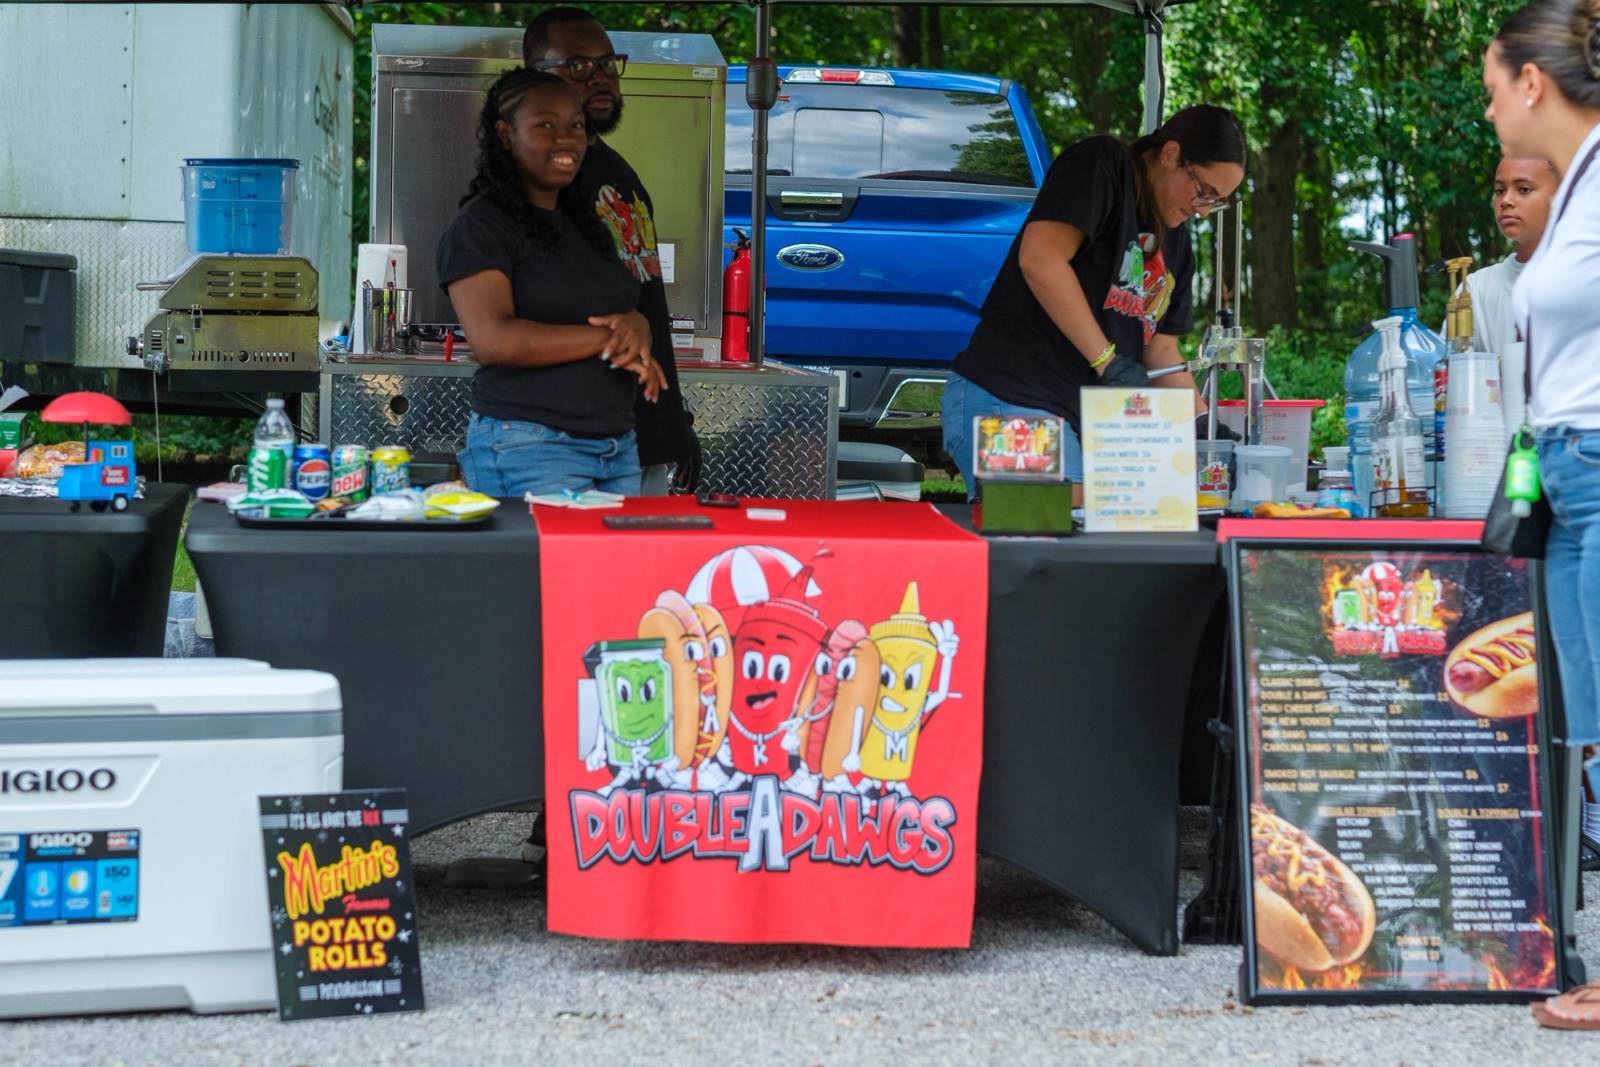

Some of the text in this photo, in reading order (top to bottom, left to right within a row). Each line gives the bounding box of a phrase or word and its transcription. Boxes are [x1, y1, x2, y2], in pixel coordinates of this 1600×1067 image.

[791, 249, 828, 265] Ford
[332, 469, 366, 495] DEW
[631, 745, 651, 772] R
[752, 743, 769, 768] K
[883, 735, 909, 763] M
[1, 768, 117, 793] IGLOO
[569, 774, 957, 876] DOUBLE A DAWGS
[277, 839, 400, 920] Martin's
[293, 914, 397, 947] POTATO
[308, 941, 387, 972] ROLLS
